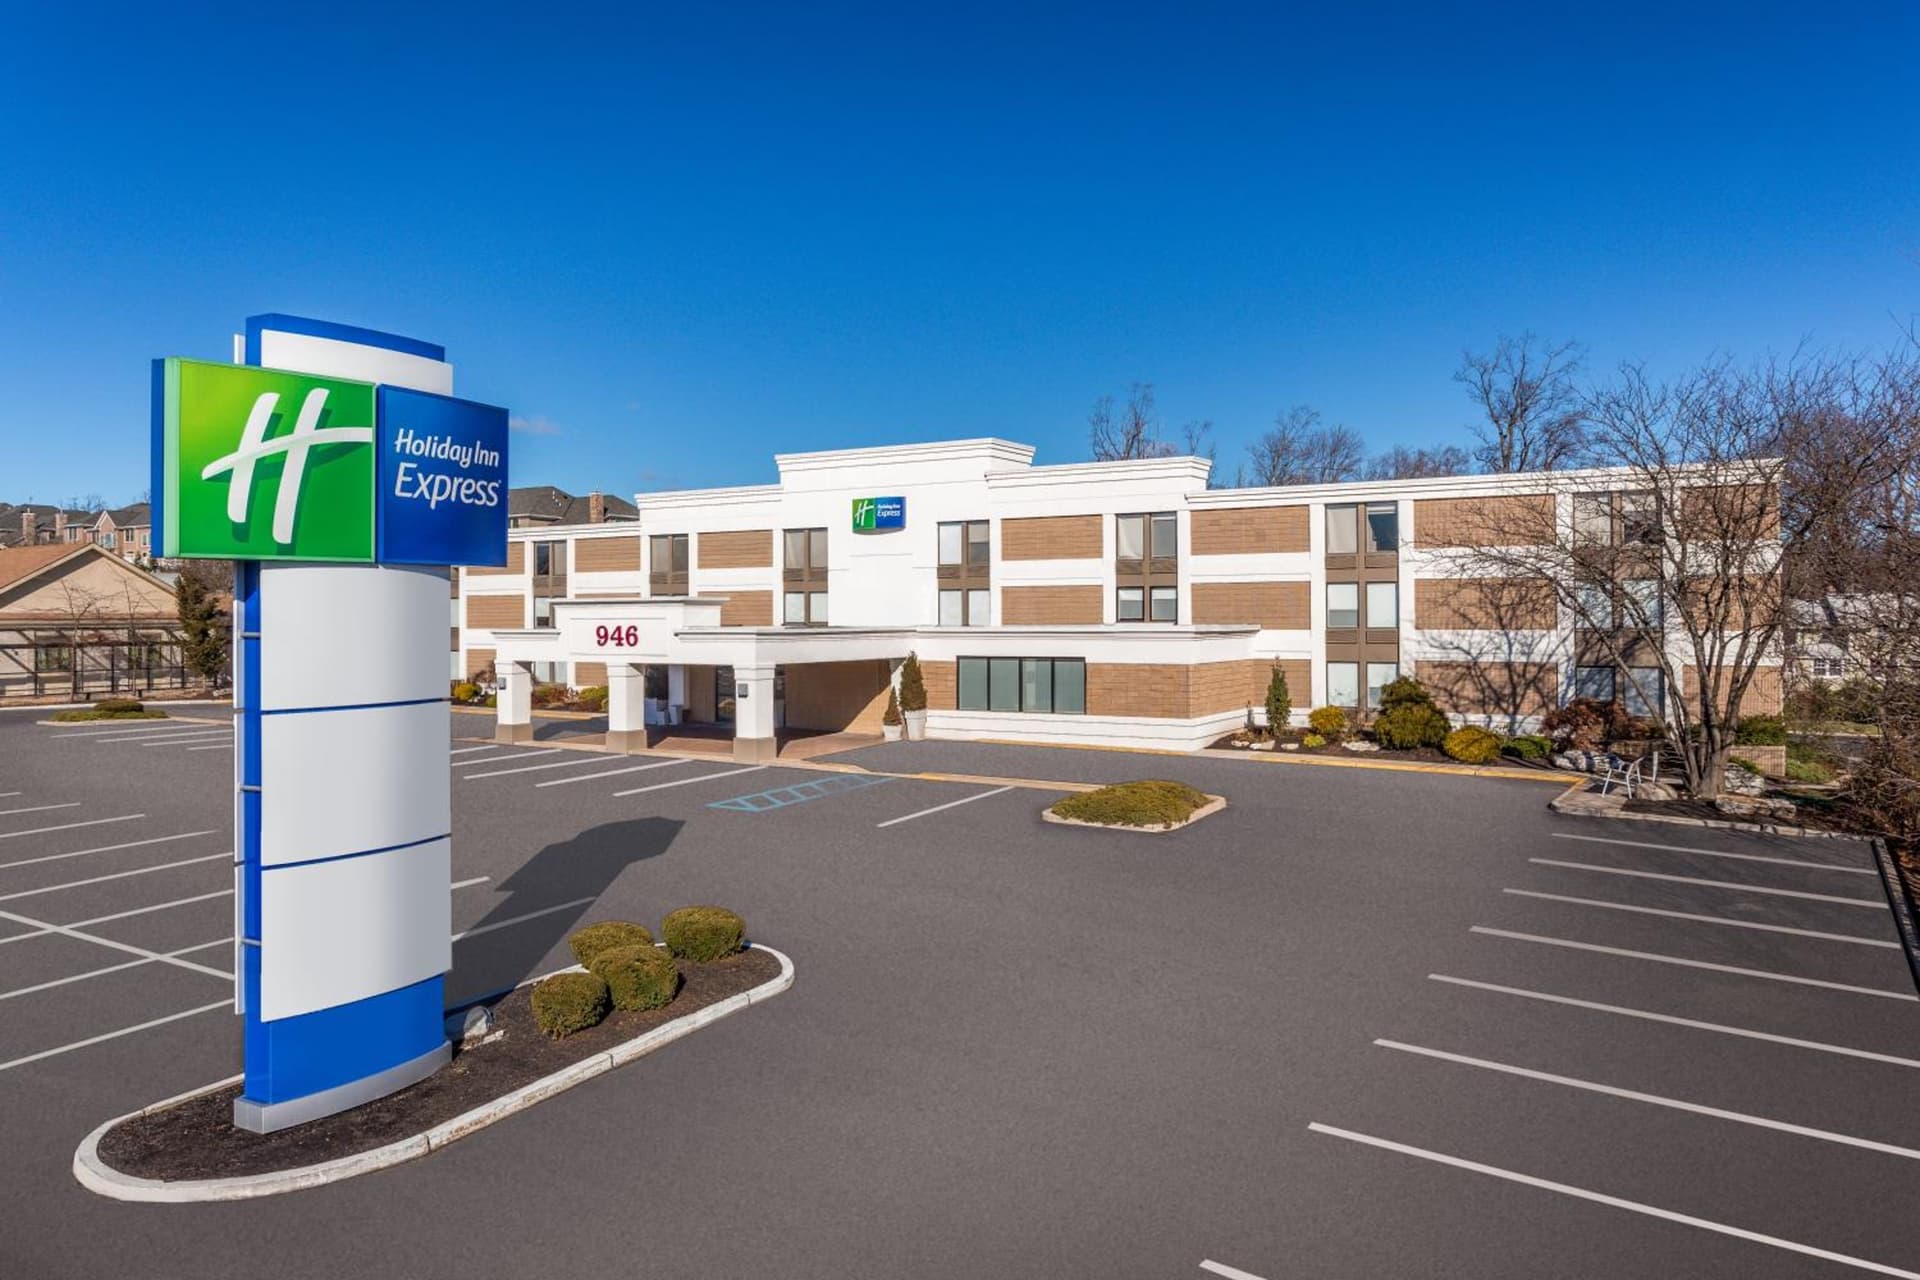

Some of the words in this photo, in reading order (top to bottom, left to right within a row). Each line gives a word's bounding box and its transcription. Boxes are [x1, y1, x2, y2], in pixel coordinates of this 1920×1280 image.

[394, 428, 472, 469] Holiday
[474, 440, 500, 468] Inn
[395, 462, 500, 510] Express
[596, 625, 638, 647] 946
